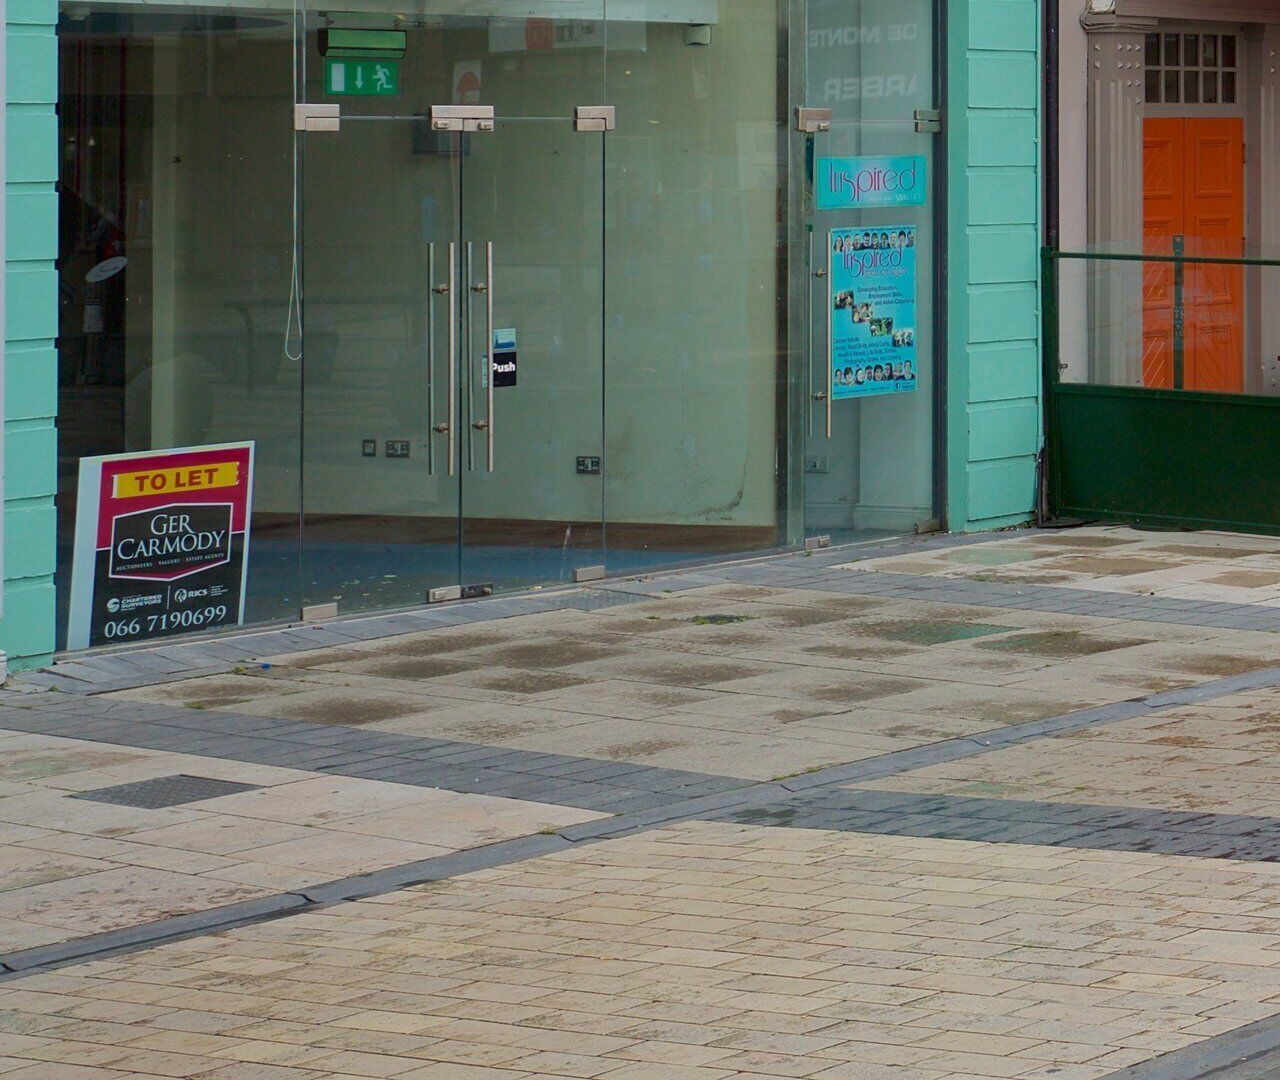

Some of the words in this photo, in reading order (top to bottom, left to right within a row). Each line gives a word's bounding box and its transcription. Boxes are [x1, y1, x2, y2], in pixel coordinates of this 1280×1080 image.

[829, 160, 916, 203] Inspired
[843, 245, 902, 278] Inspired
[493, 361, 516, 373] Push
[135, 474, 167, 492] TO
[174, 468, 219, 488] LET
[151, 514, 195, 536] GER
[117, 530, 225, 560] CARMODY
[188, 588, 208, 598] RICS
[104, 618, 140, 638] 066
[147, 605, 227, 632] 7190699
